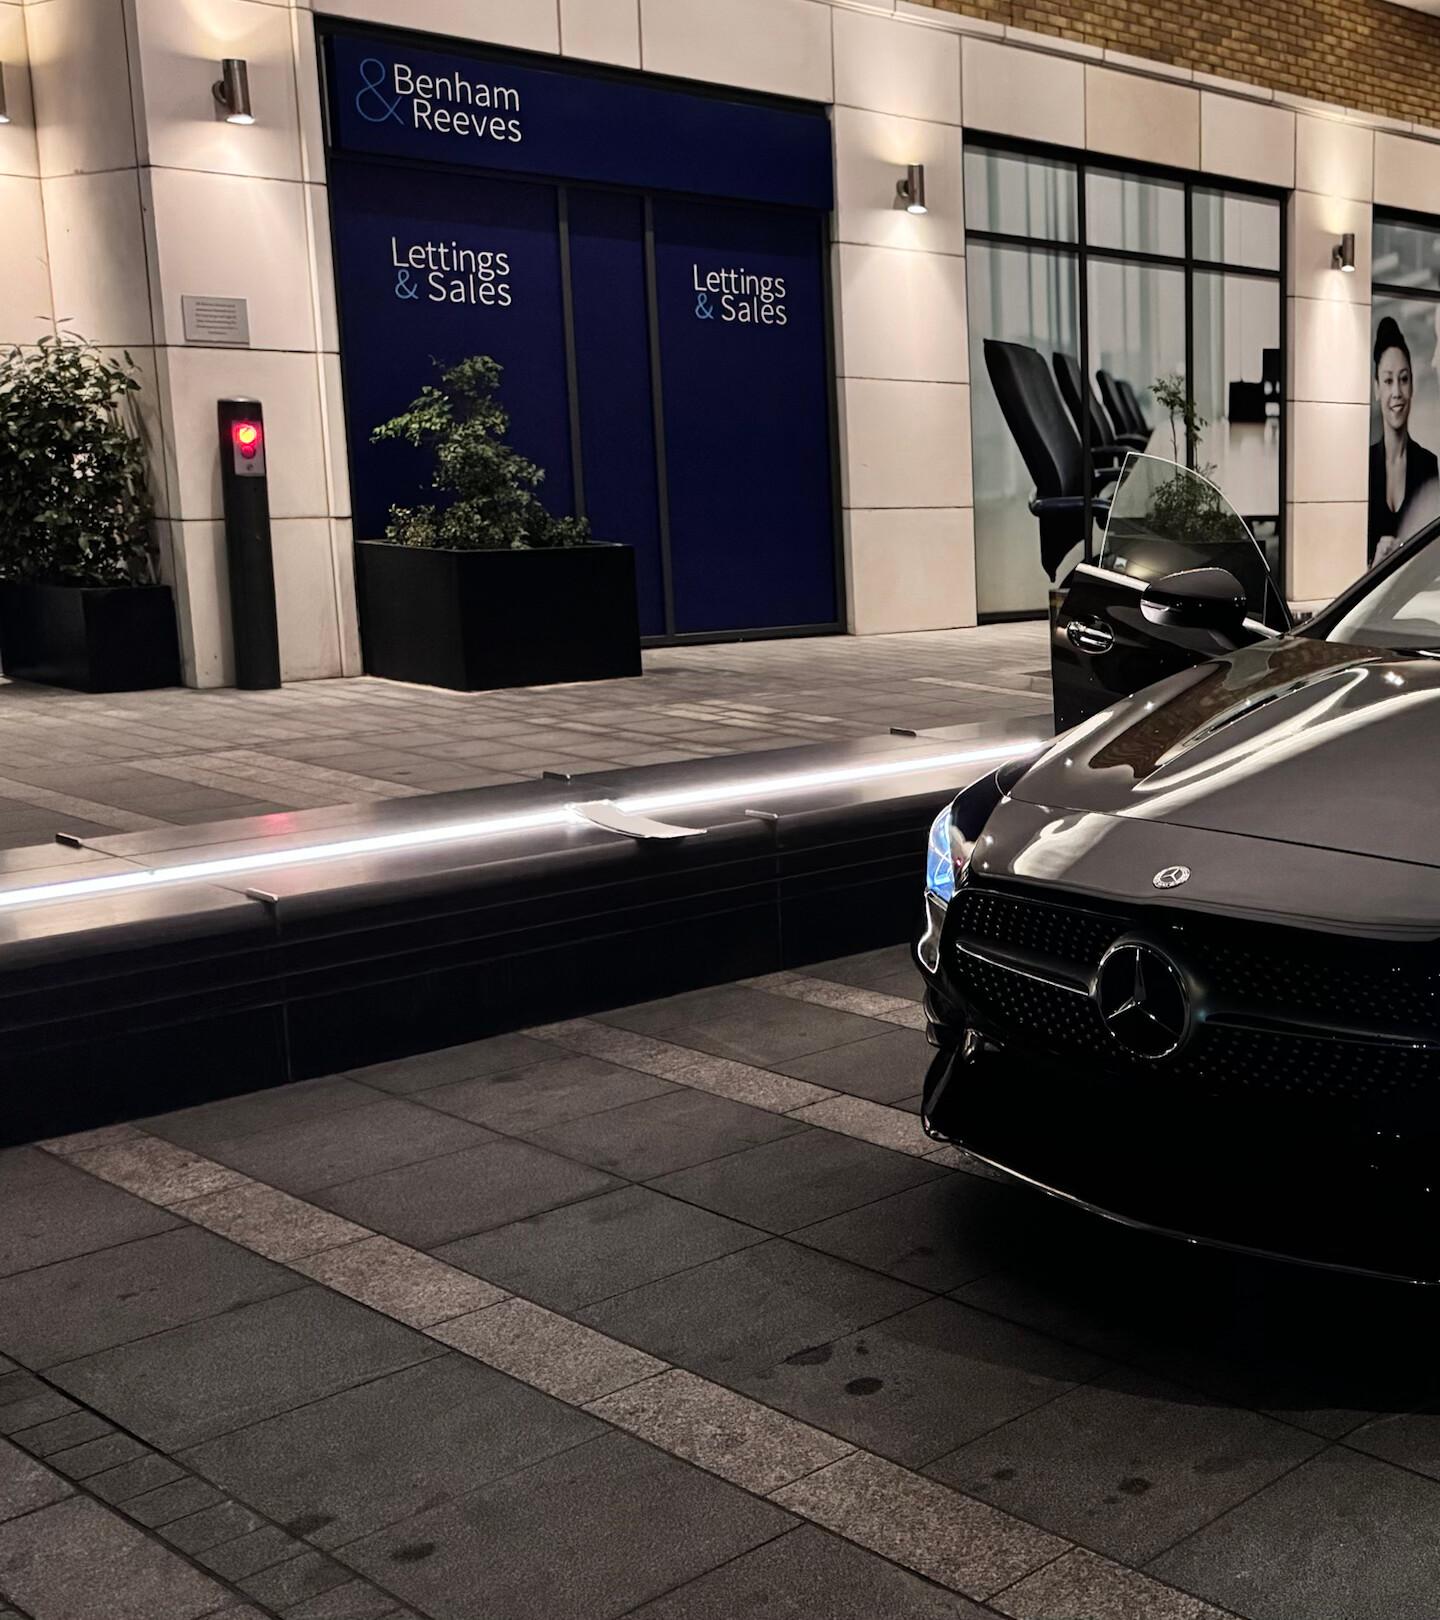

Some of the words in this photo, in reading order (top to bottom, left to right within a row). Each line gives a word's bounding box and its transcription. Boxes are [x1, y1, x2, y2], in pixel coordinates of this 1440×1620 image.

[356, 57, 405, 126] &
[393, 63, 520, 112] Benham
[413, 98, 522, 143] Reeves
[391, 236, 510, 282] Lettings
[394, 269, 419, 300] &
[428, 271, 512, 307] Sales
[693, 263, 786, 304] Lettings
[695, 292, 714, 320] &
[721, 294, 788, 325] Sales
